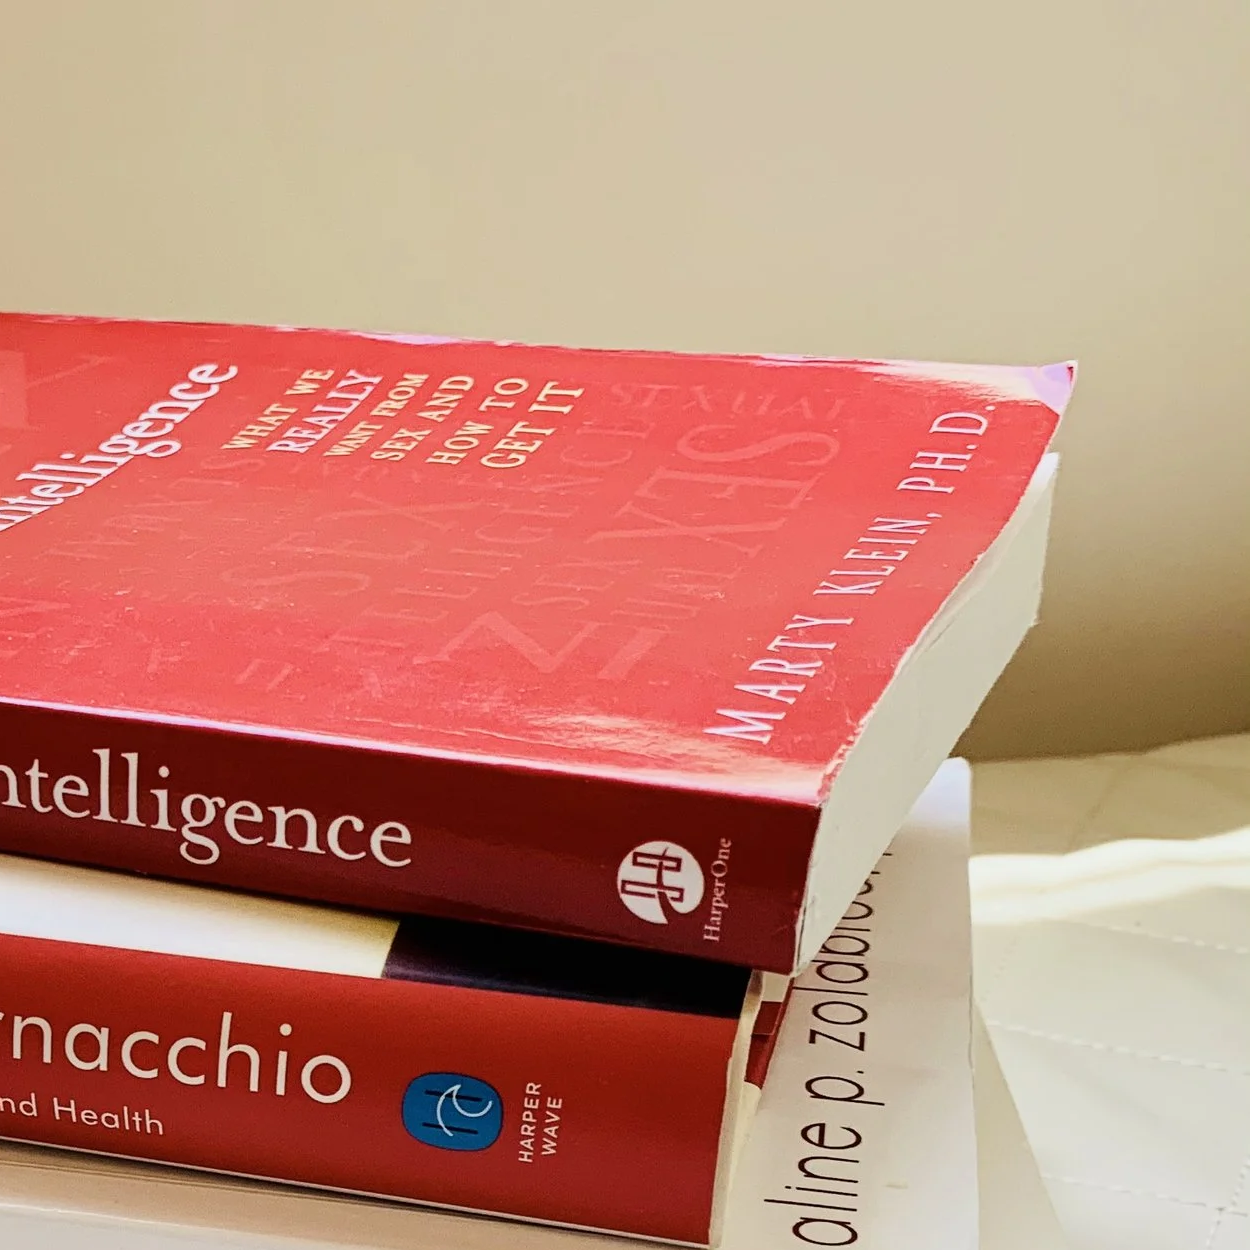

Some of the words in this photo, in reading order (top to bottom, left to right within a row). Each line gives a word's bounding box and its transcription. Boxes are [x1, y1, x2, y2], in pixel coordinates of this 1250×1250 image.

[220, 402, 301, 451] WHAT
[285, 368, 335, 396] WE
[265, 369, 384, 454] REALLY
[323, 420, 384, 458] WANT
[369, 372, 430, 418] FROM
[369, 427, 432, 462] SEX
[416, 375, 475, 423] AND
[425, 420, 496, 466] HOW
[478, 376, 530, 412] TO
[478, 421, 558, 469] GET
[527, 380, 586, 415] IT
[703, 610, 857, 745] MARTY
[812, 507, 946, 598] KLEIN,
[896, 402, 1000, 496] PH.D.
[703, 837, 733, 942] HarperOne
[53, 1096, 165, 1136] Health
[518, 1082, 542, 1163] HARPER
[540, 1096, 563, 1156] WAVE
[805, 1070, 885, 1106] p.
[763, 1122, 862, 1247] aline
